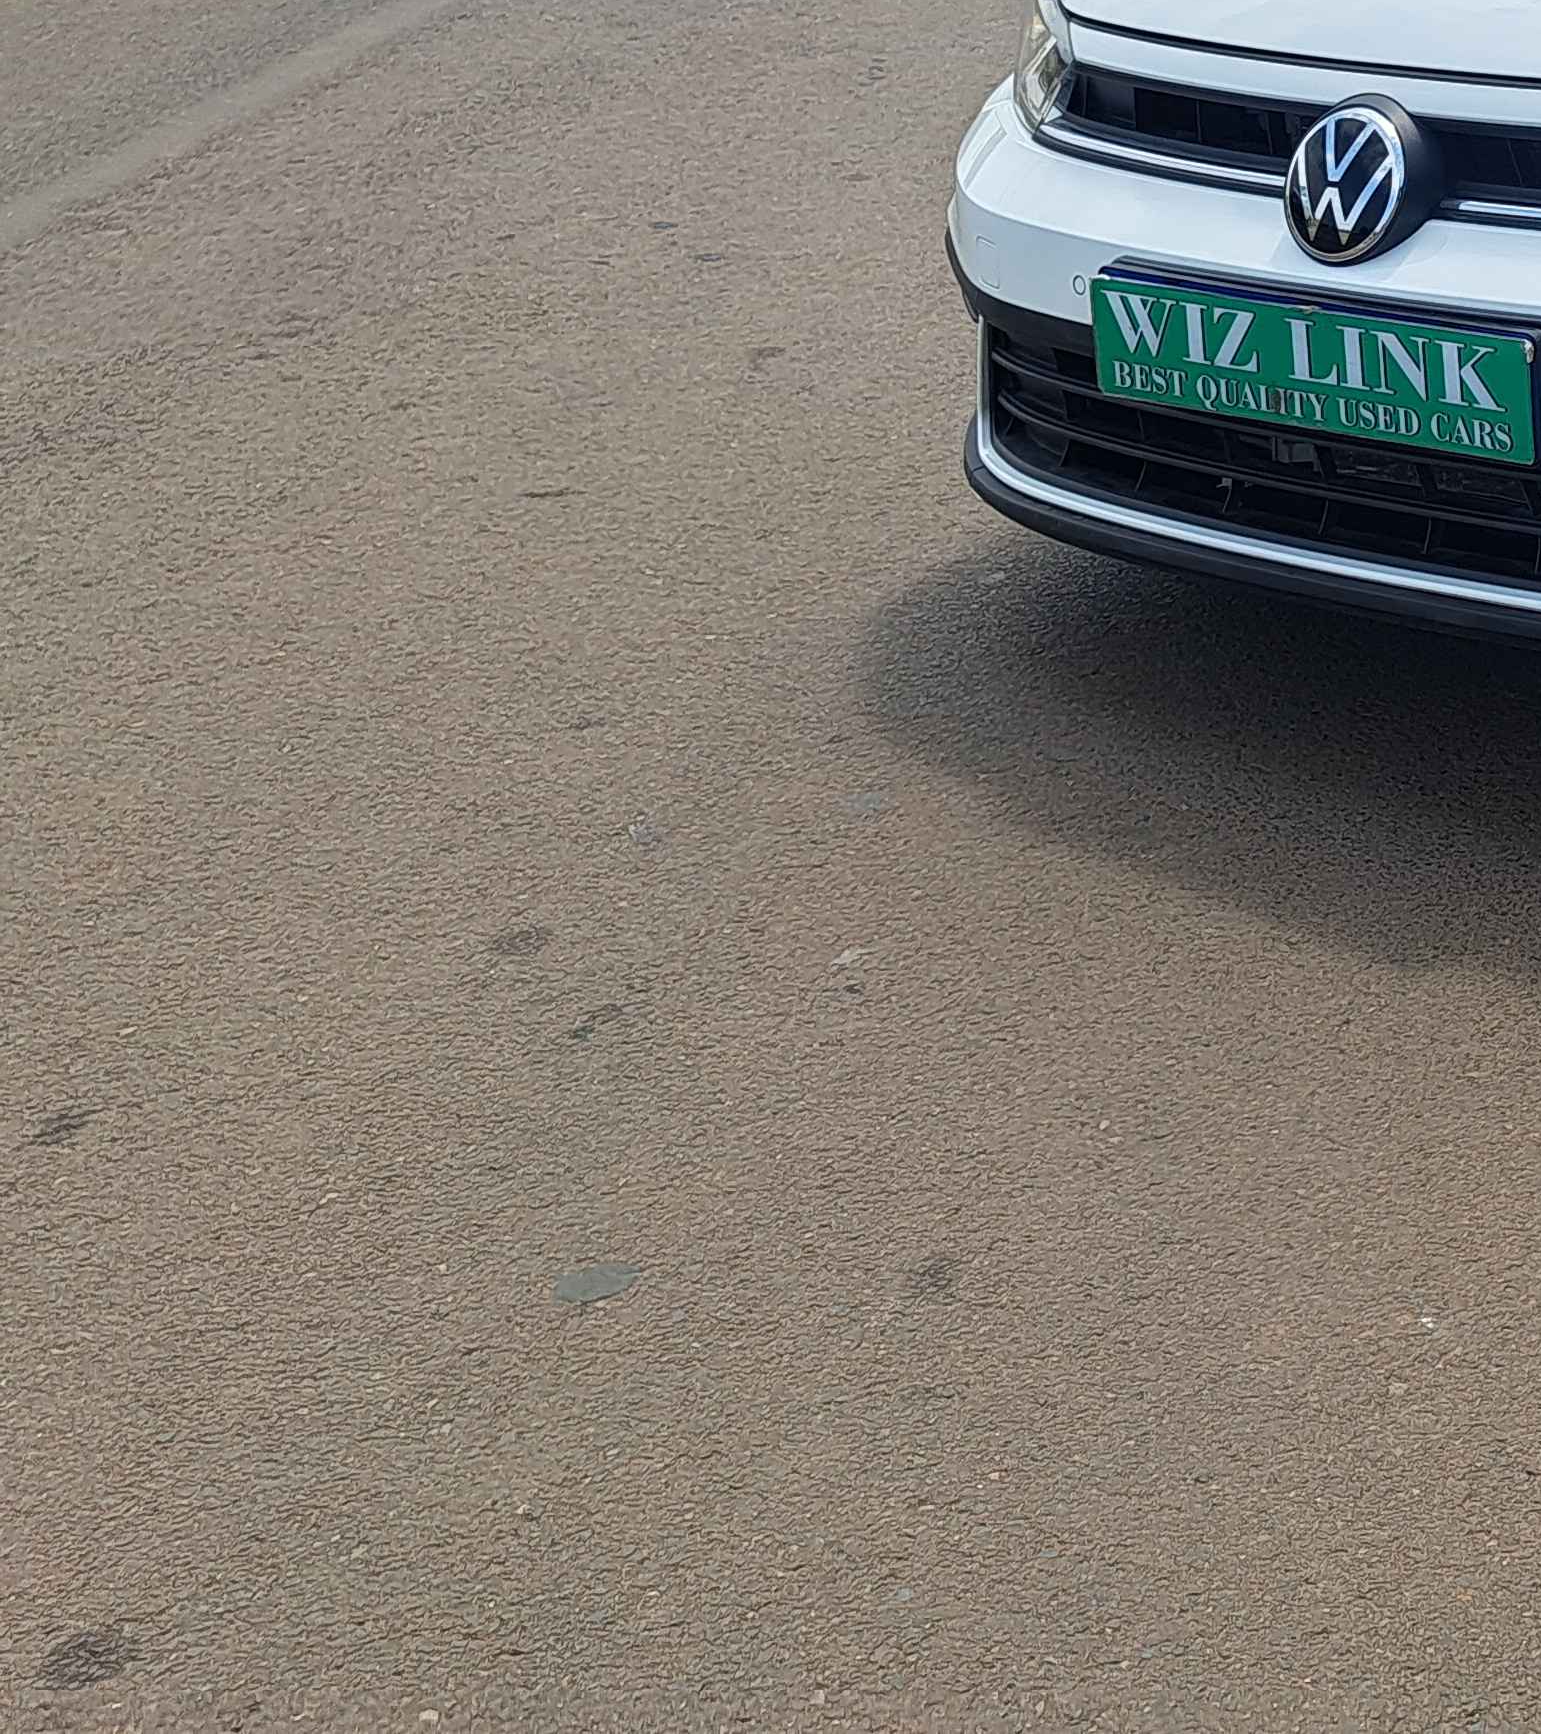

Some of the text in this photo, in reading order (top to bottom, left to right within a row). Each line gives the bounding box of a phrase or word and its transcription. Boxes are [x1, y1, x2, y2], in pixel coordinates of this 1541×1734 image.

[1100, 289, 1508, 414] WIZ LINK
[1113, 361, 1515, 454] BEST QUALITY USED CARS
